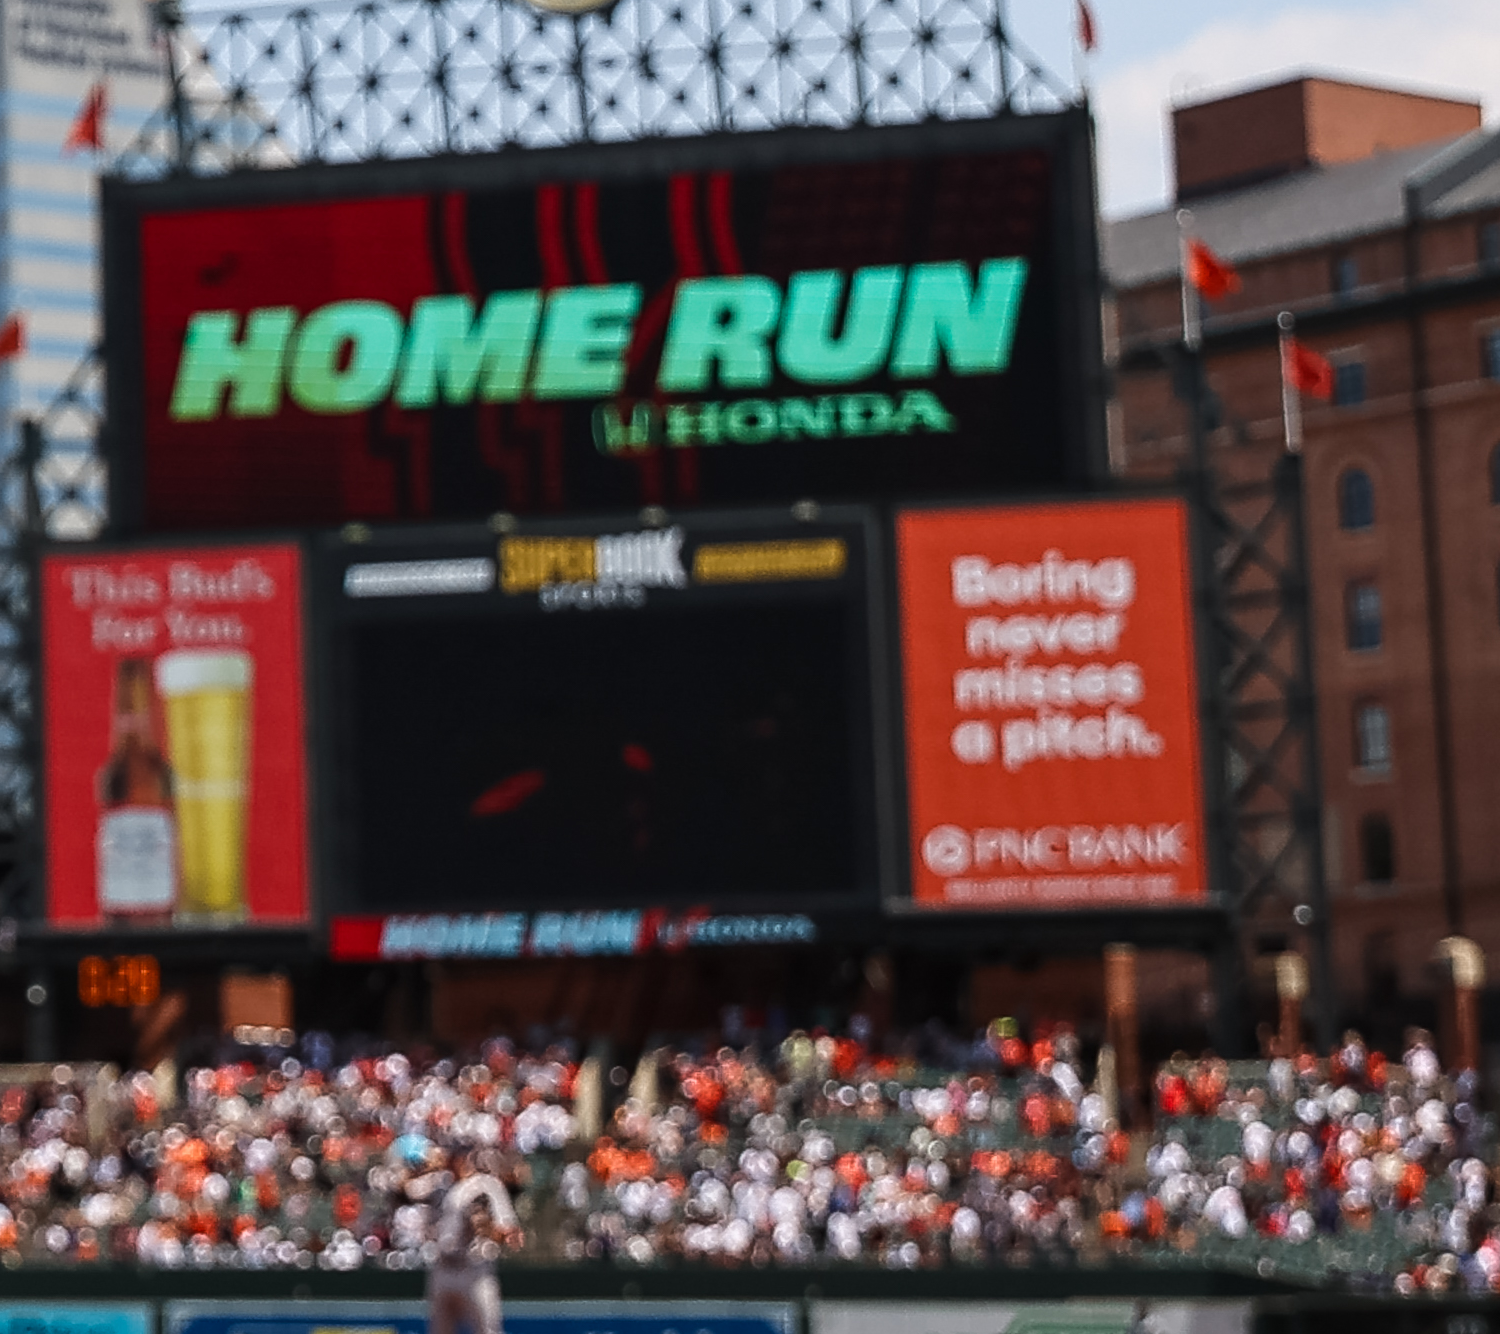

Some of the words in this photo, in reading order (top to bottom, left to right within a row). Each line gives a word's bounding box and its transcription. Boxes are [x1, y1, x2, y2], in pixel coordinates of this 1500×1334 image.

[169, 283, 644, 422] HOME
[655, 255, 1030, 394] RUN
[663, 389, 957, 449] HONDA
[62, 565, 162, 609] This
[951, 547, 1136, 608] Boring
[964, 611, 1128, 659] never
[953, 655, 1145, 711] misses
[950, 718, 998, 765] a
[1001, 704, 1164, 772] pitch.
